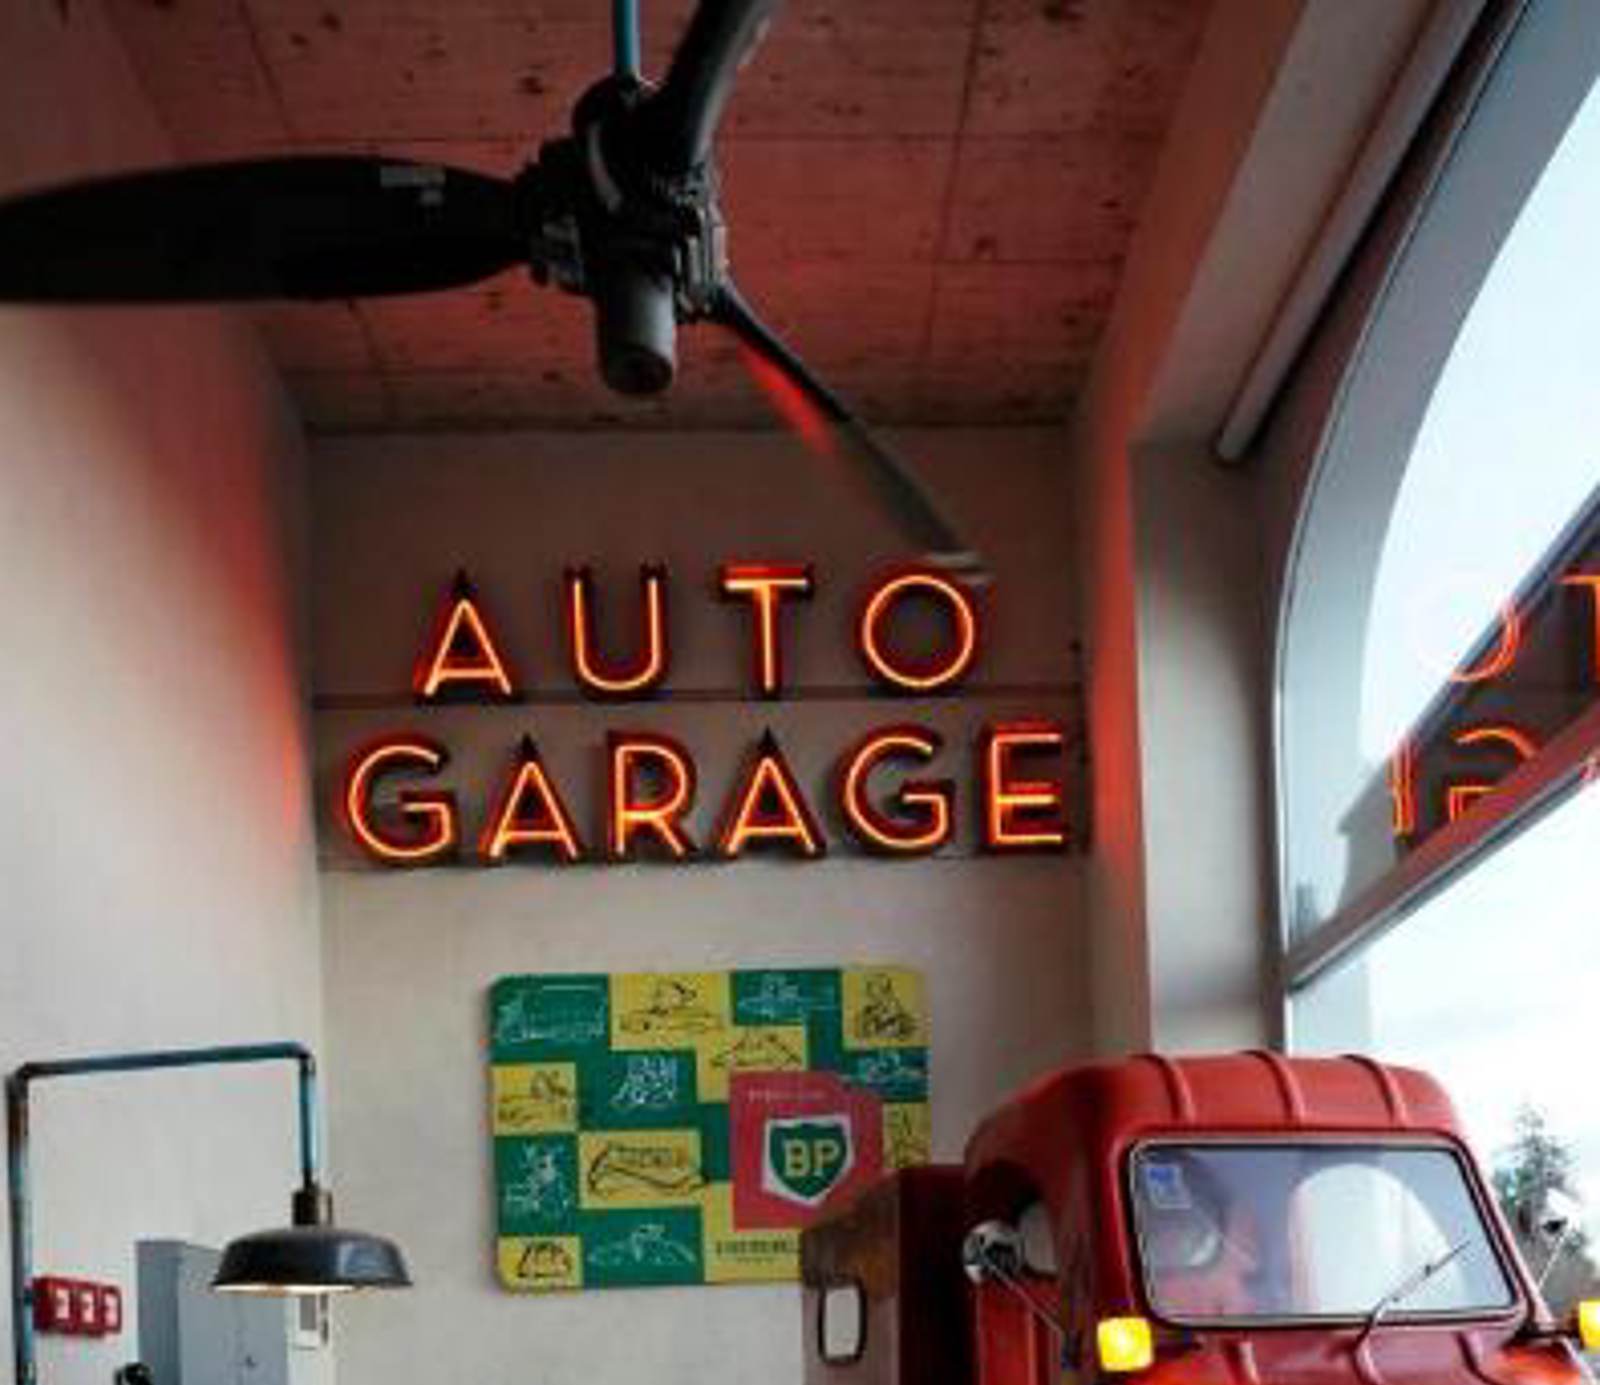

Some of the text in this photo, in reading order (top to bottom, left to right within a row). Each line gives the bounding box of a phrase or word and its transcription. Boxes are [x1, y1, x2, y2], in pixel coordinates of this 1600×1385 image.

[414, 564, 984, 701] AUTO
[338, 719, 1069, 864] GARAGE
[785, 1139, 840, 1177] BP
